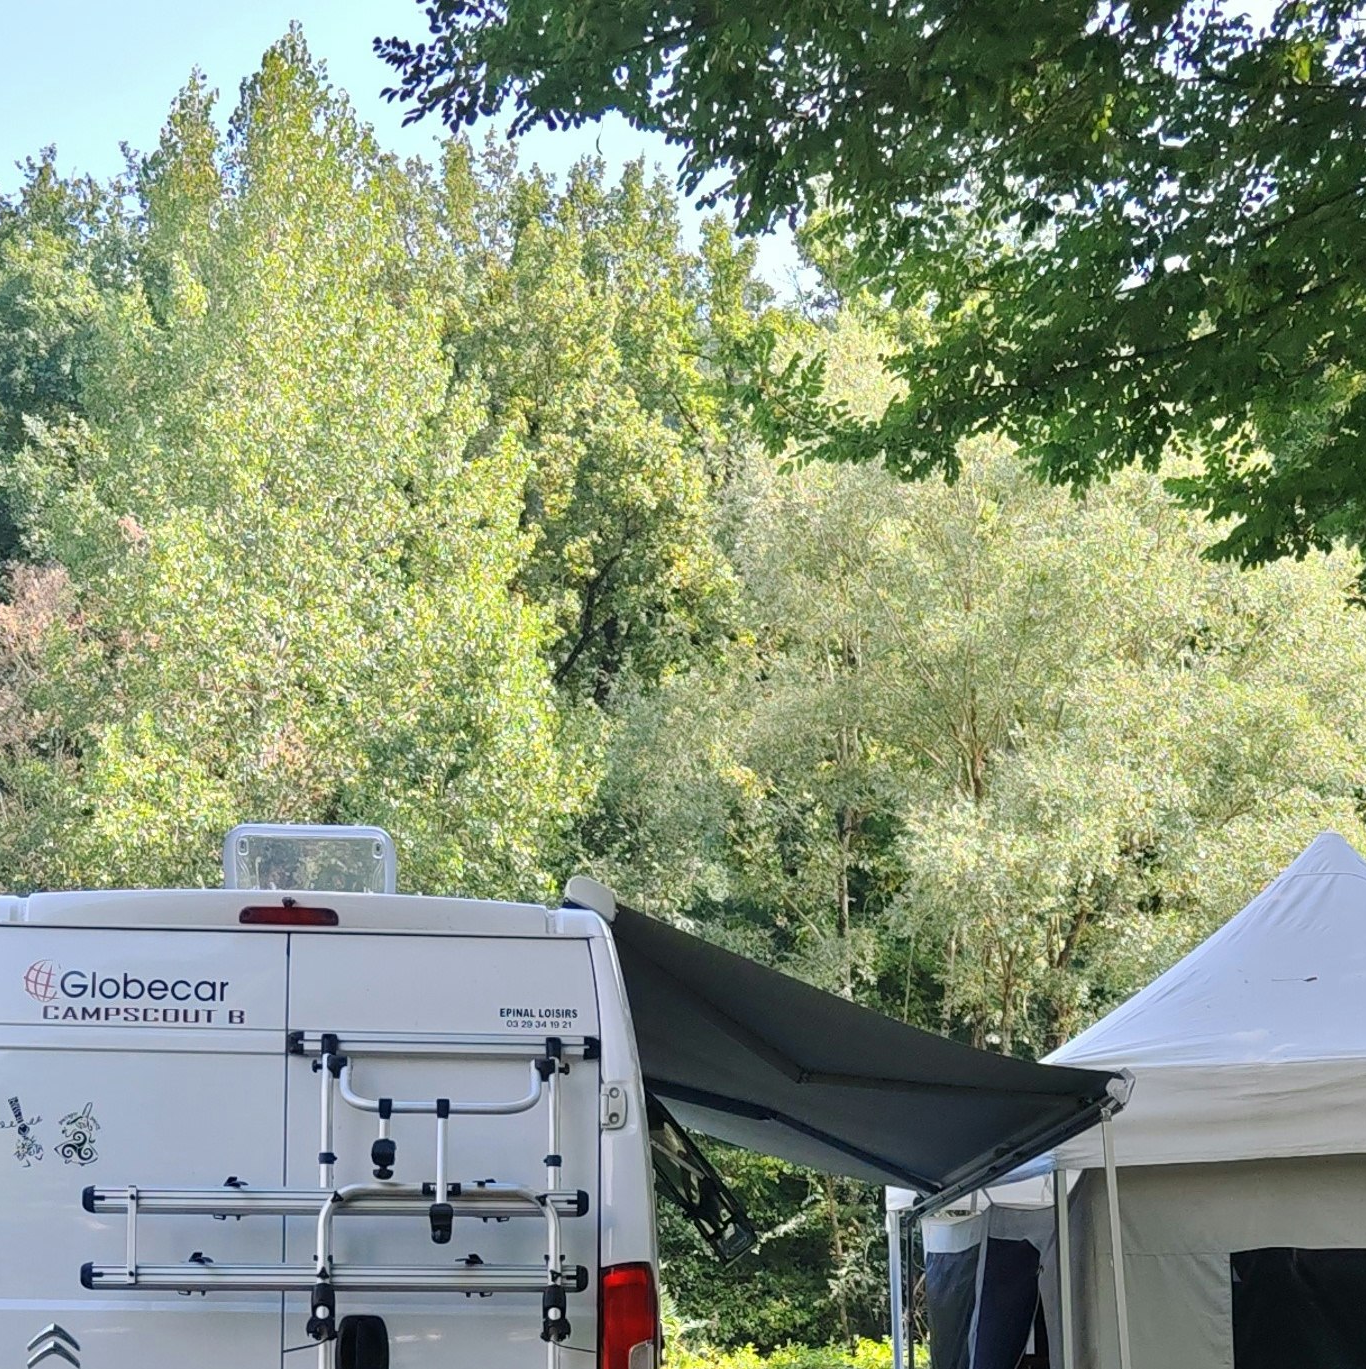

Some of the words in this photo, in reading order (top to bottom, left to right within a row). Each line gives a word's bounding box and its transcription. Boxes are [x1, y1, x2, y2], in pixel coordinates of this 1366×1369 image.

[60, 970, 229, 1002] Globecar
[42, 1005, 218, 1023] CAMPSCOUT
[228, 1009, 245, 1025] B
[499, 1008, 536, 1018] EPINAL
[538, 1008, 578, 1019] LOISIRS
[506, 1020, 519, 1028] 03
[521, 1020, 533, 1029] 29
[535, 1020, 547, 1029] 34
[550, 1020, 560, 1029] 19
[562, 1021, 572, 1029] 21
